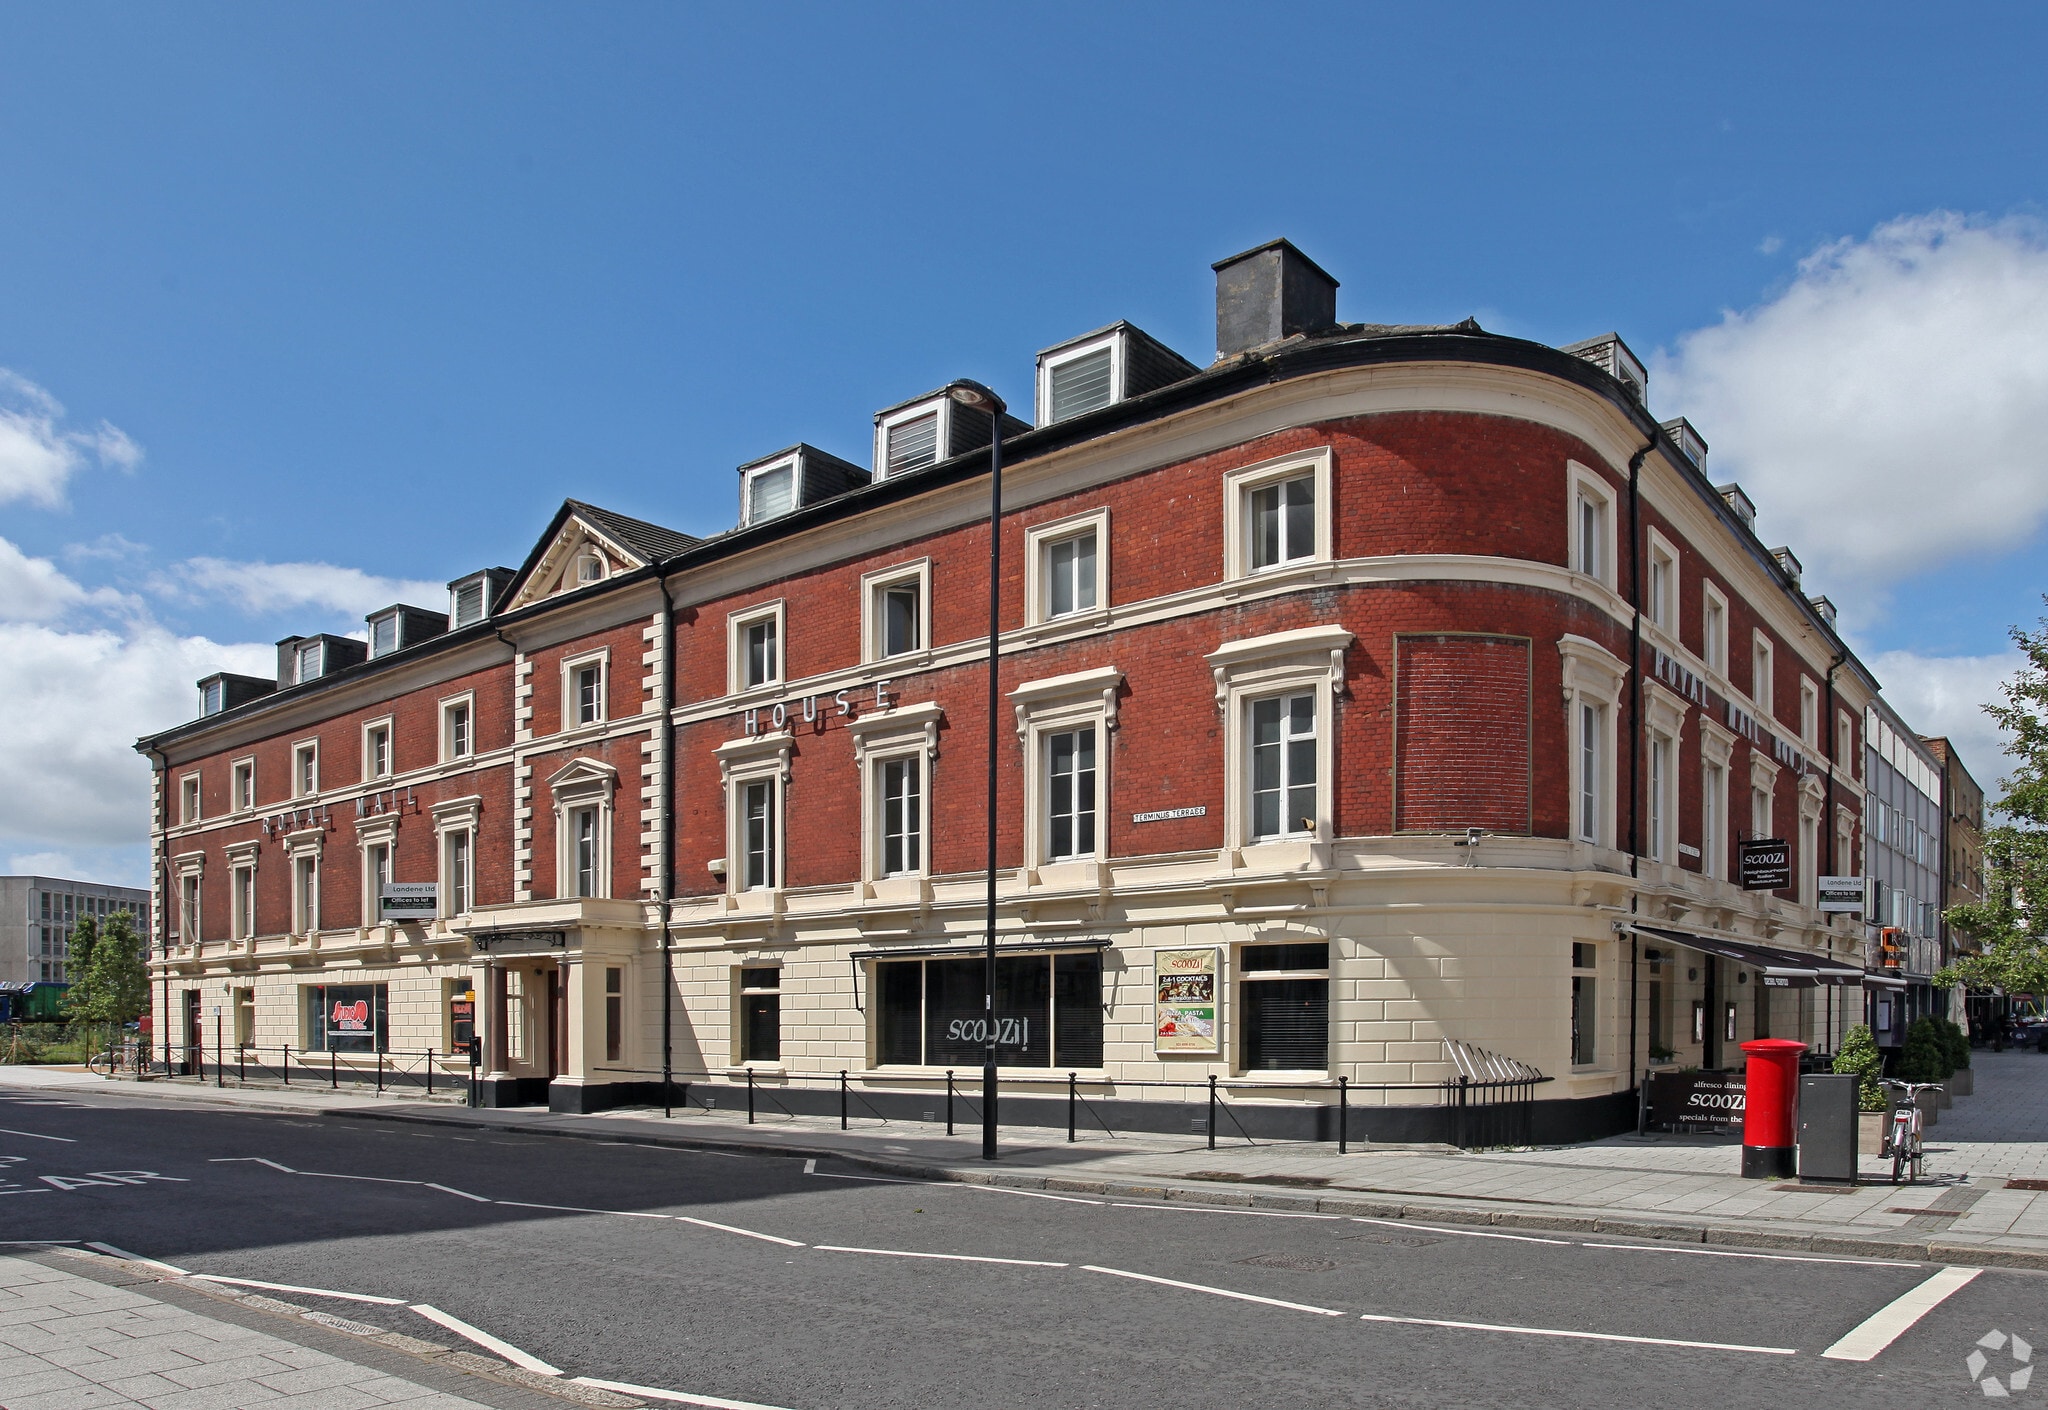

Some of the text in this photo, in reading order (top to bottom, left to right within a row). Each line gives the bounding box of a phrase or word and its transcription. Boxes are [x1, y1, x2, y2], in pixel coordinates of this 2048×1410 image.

[262, 680, 891, 833] ROYAL MAIL HOUSE
[1135, 808, 1205, 821] TERMINUS TERRACE
[1744, 867, 1789, 875] Neighbourhood
[1694, 1081, 1722, 1089] alfresco
[1679, 1114, 1707, 1122] specials
[1710, 1114, 1728, 1122] from
